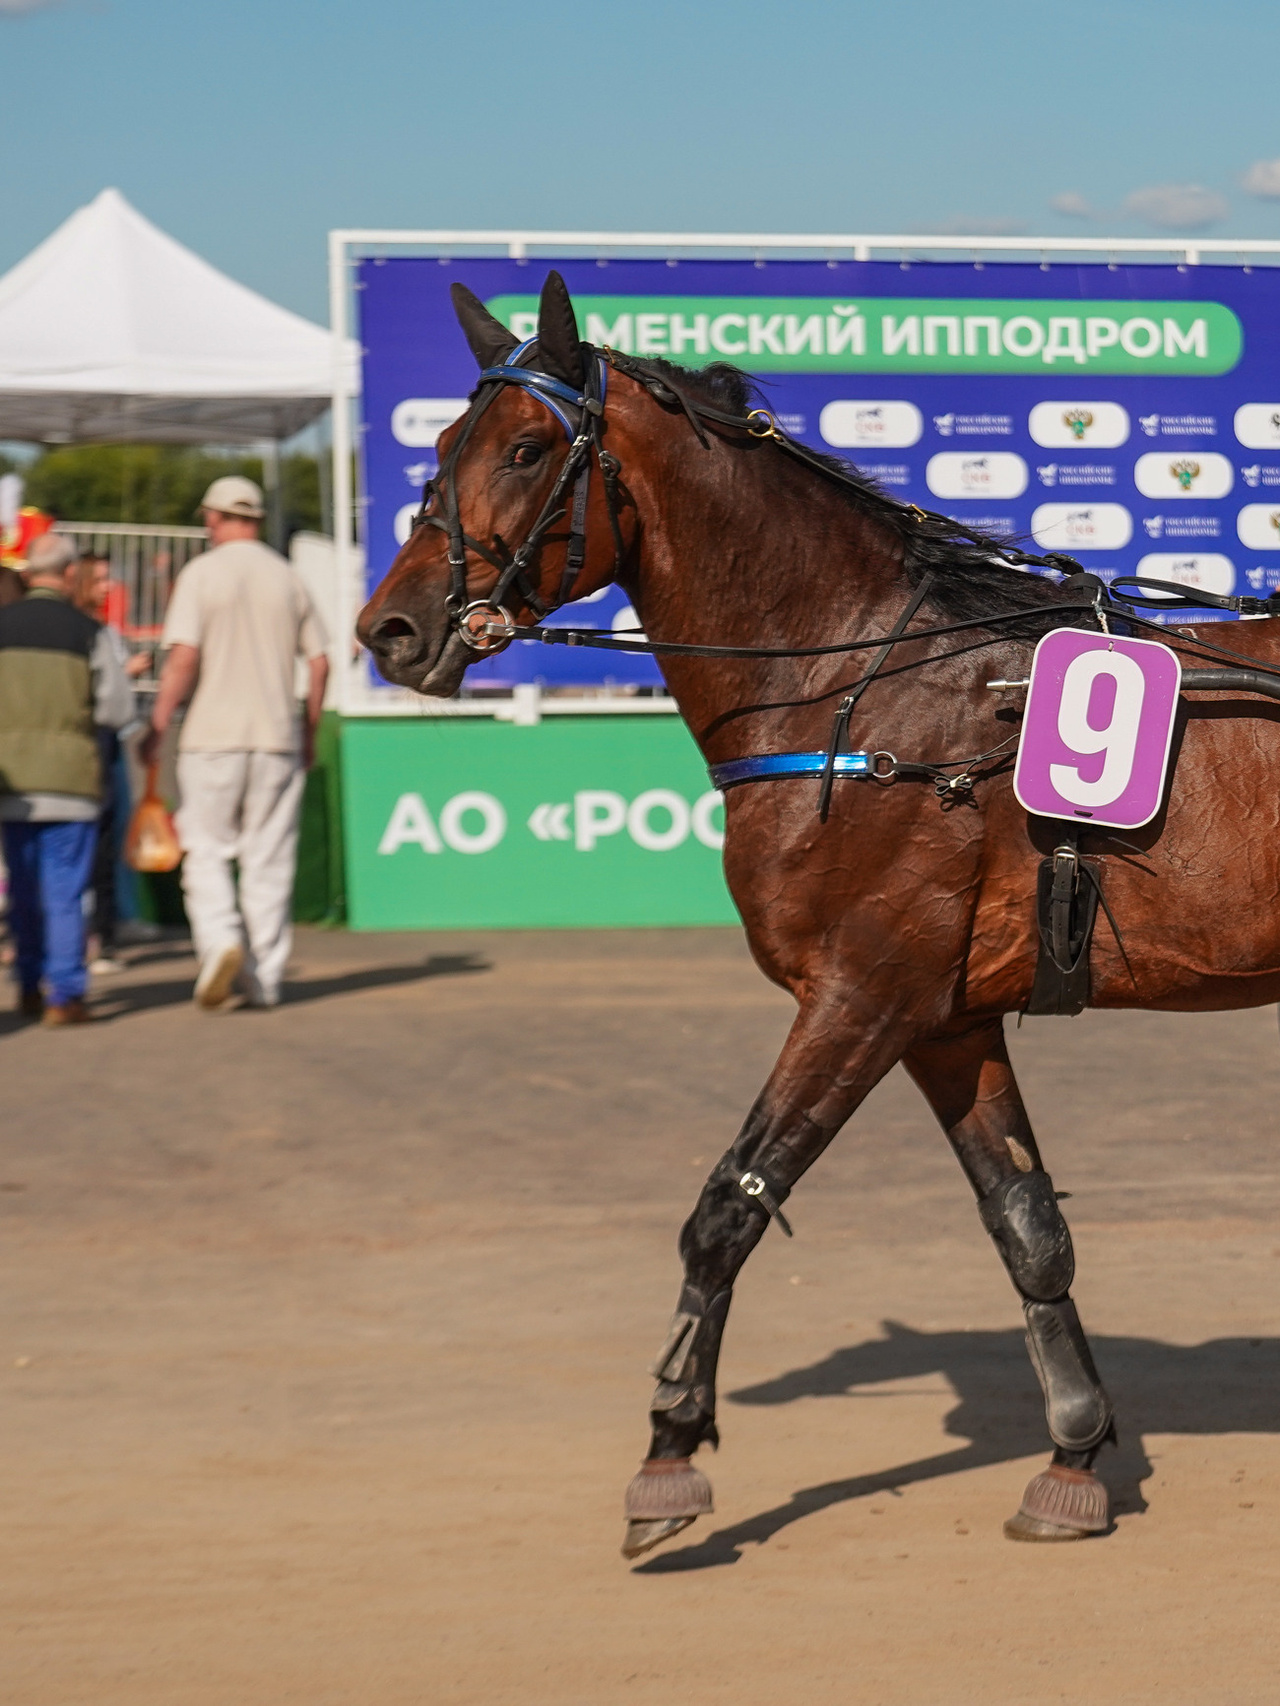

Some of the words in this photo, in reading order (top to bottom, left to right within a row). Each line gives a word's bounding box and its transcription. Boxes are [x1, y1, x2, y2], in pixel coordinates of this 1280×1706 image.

[509, 304, 867, 355] РМЕНСКИЙ
[881, 315, 1209, 364] ИППОДРОМ
[1049, 649, 1145, 807] 9
[377, 789, 507, 855] АО
